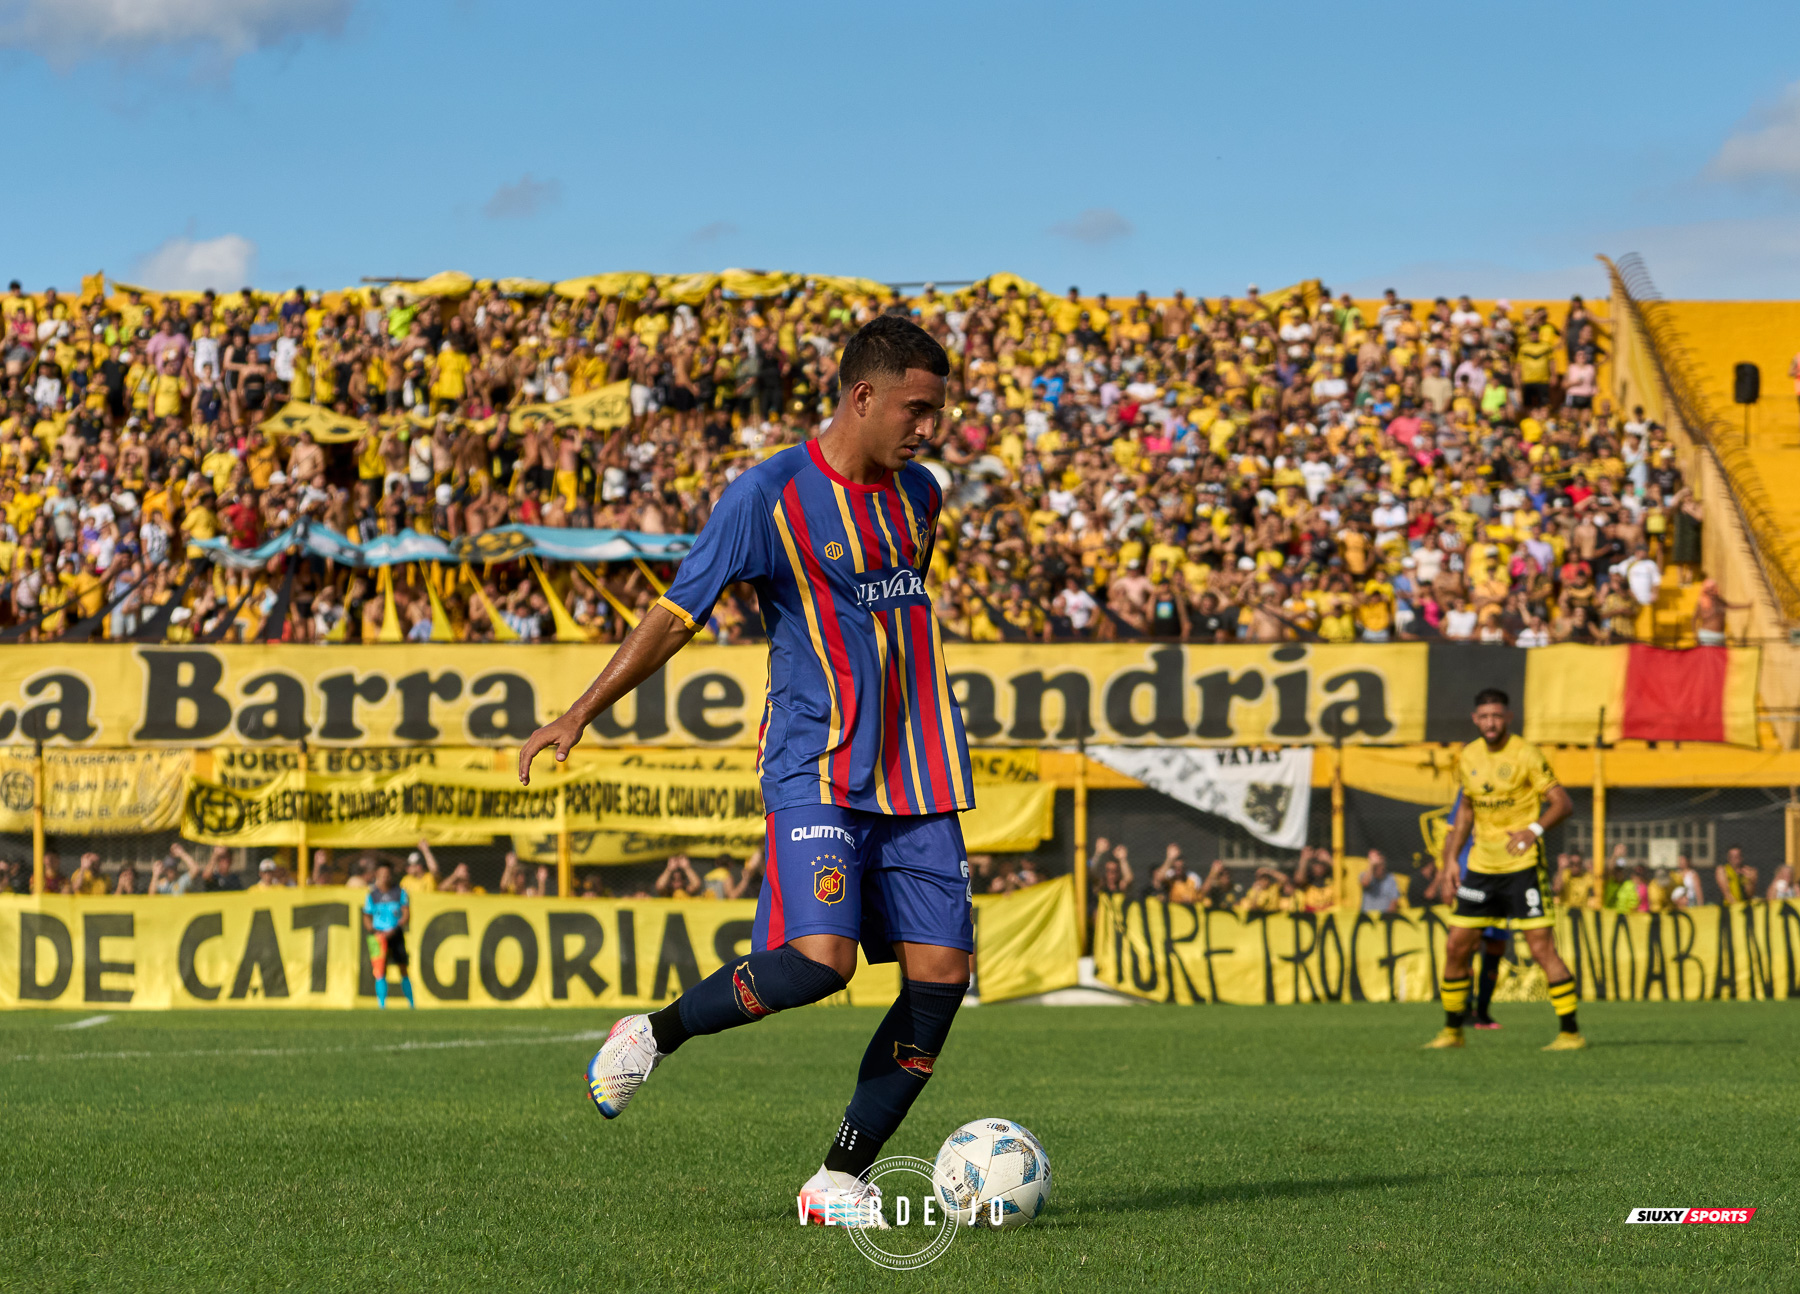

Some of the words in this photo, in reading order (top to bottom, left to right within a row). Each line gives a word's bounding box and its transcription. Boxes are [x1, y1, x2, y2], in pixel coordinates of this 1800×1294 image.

[134, 650, 540, 741] Barra
[948, 645, 1394, 740] andria
[403, 783, 454, 815] MENOS
[666, 786, 728, 819] CUANDO
[19, 912, 134, 1003] DE
